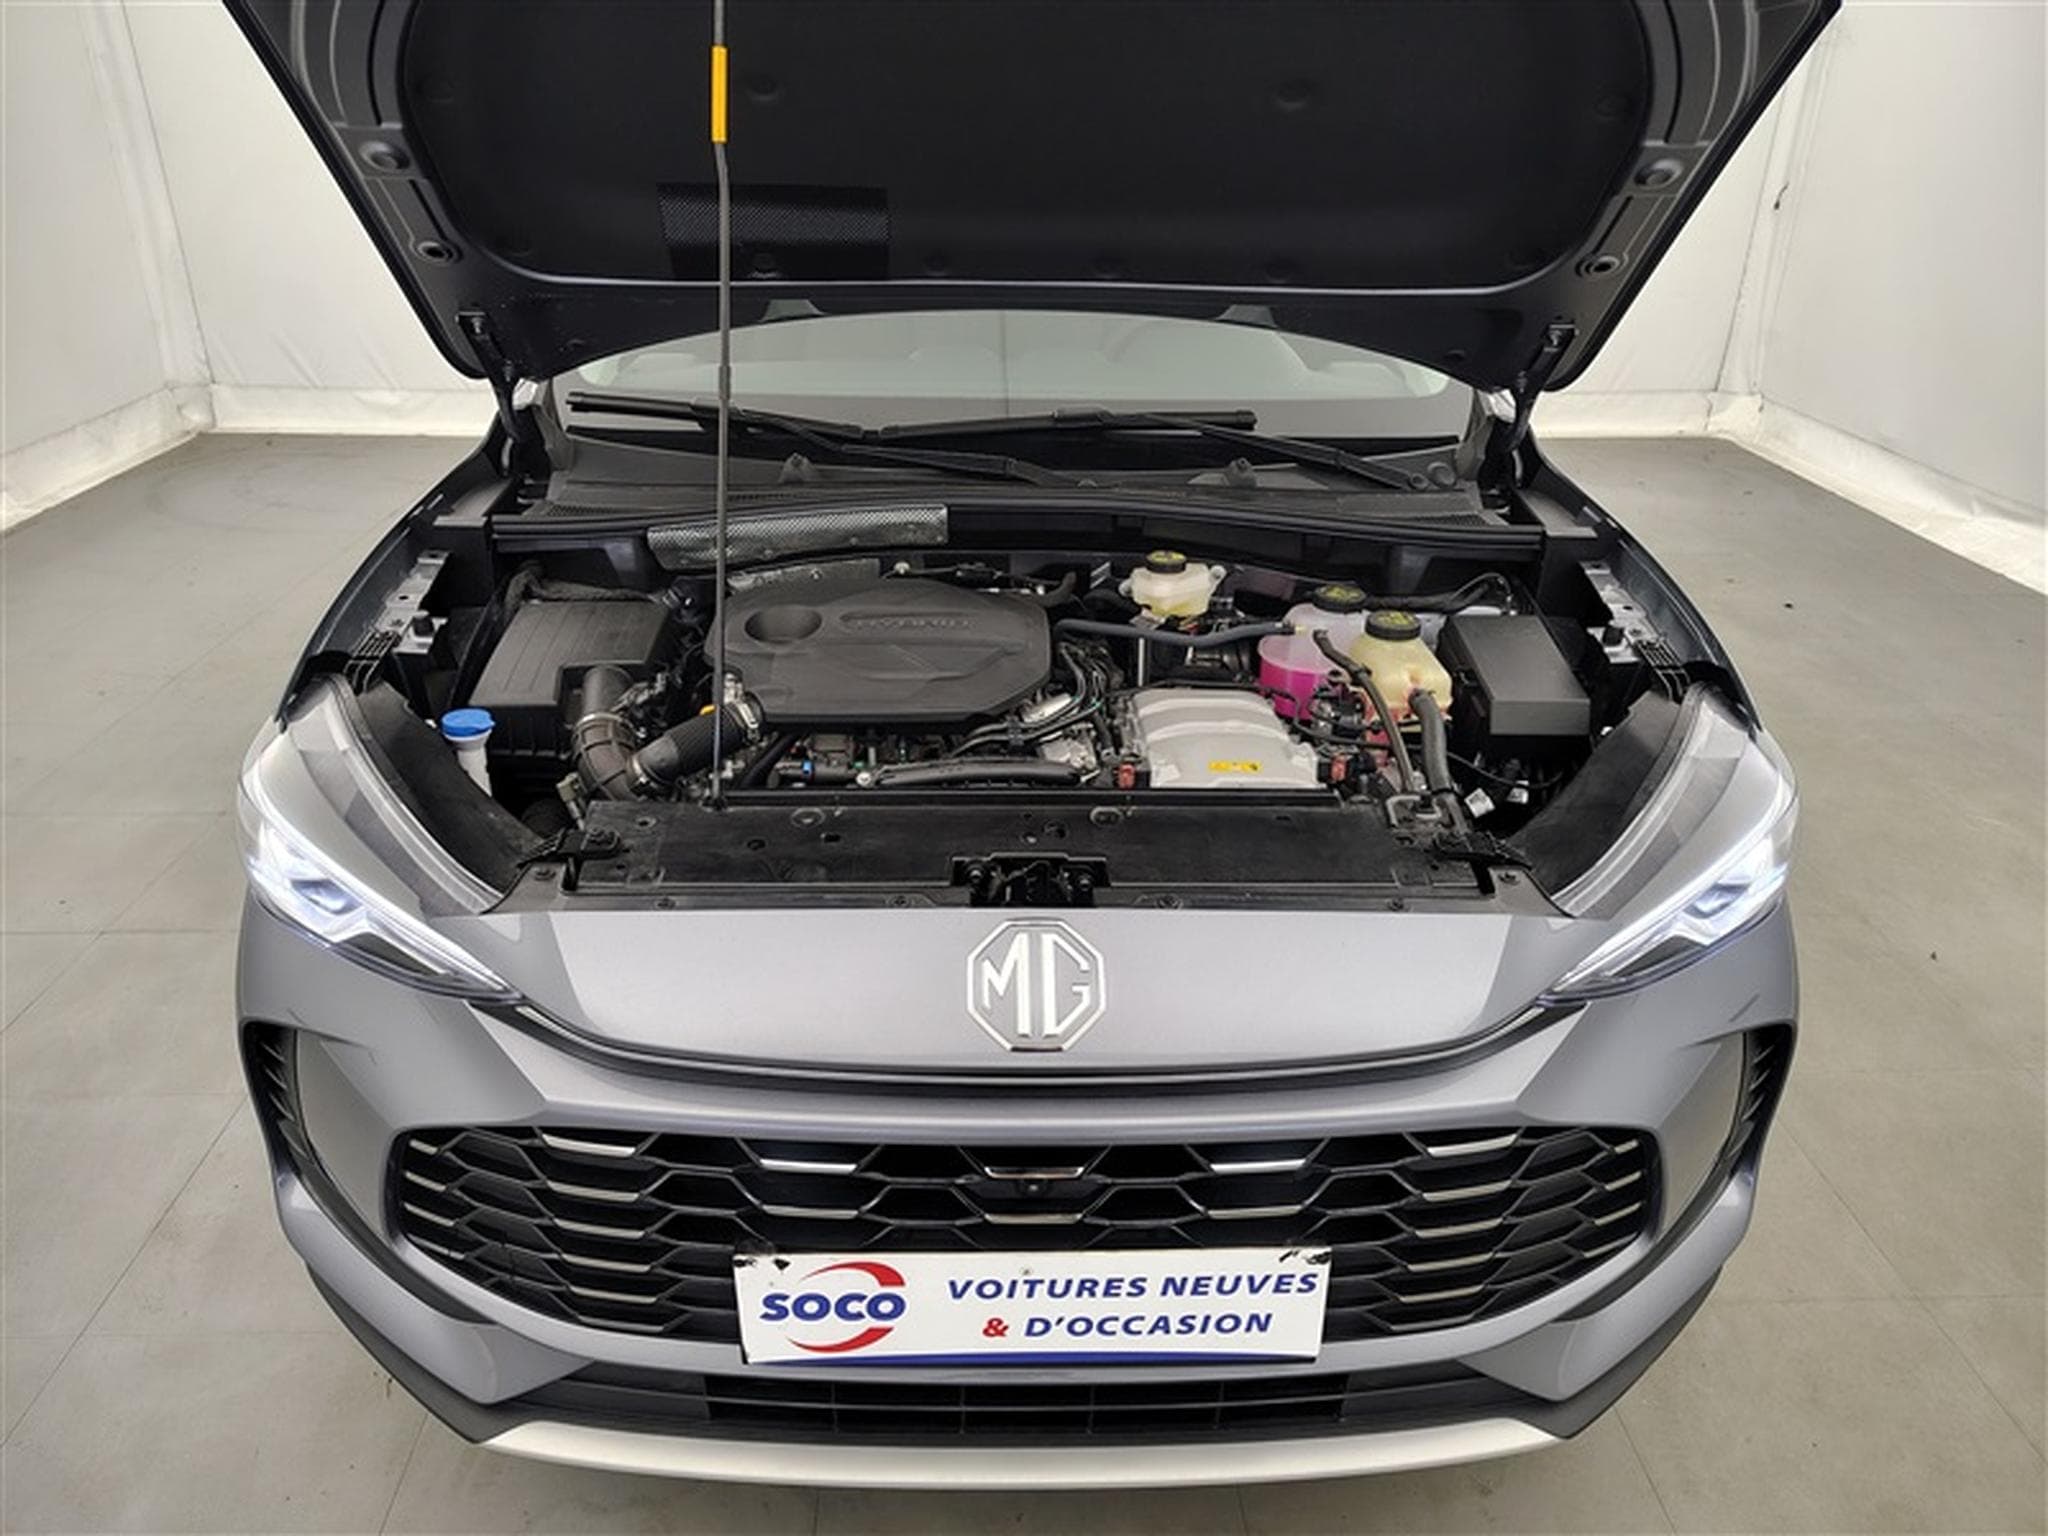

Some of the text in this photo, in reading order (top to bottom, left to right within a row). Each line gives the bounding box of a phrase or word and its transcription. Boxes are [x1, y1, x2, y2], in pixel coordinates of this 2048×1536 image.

[981, 932, 1091, 1036] MG
[948, 1273, 1319, 1299] VOITURES NEUVES
[759, 1293, 906, 1321] SOCO
[982, 1313, 1273, 1338] & D'OCCASION
